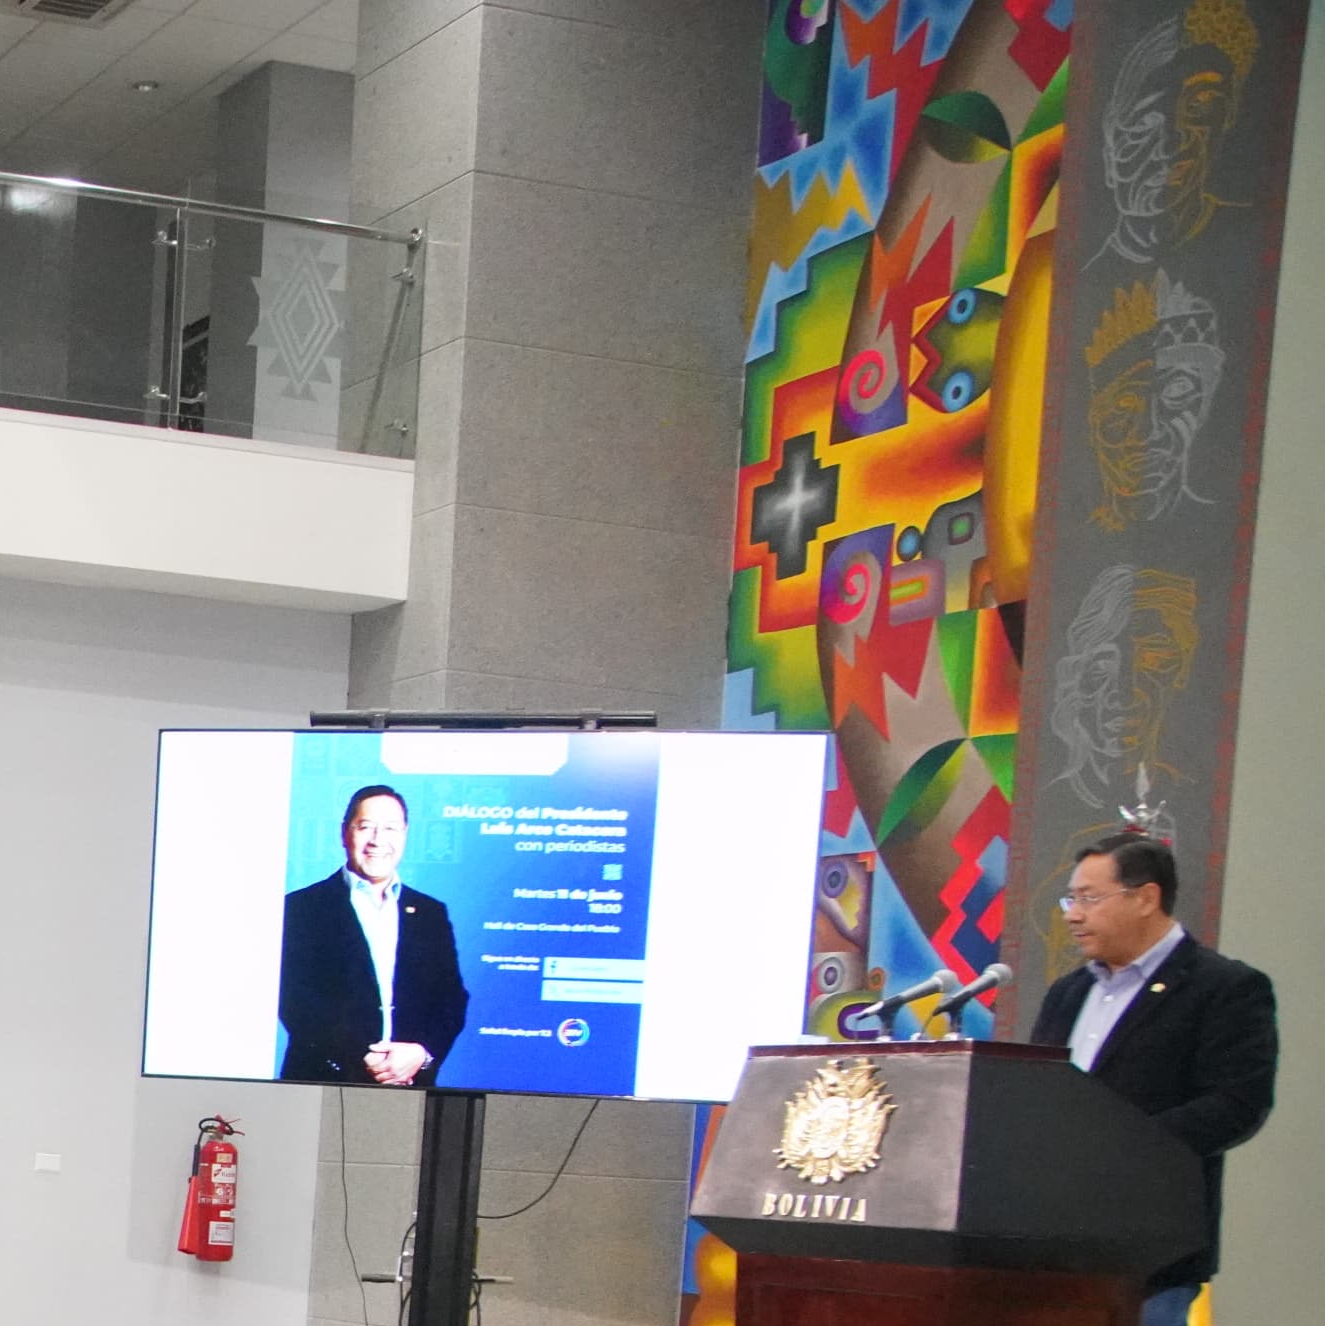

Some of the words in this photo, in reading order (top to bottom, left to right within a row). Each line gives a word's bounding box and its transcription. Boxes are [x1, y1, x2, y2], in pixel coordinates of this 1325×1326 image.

[443, 804, 514, 819] DIÁLOGO
[515, 807, 539, 819] del
[515, 841, 542, 851] con
[544, 840, 626, 854] periodistas
[762, 1193, 867, 1222] BOLIVIA
